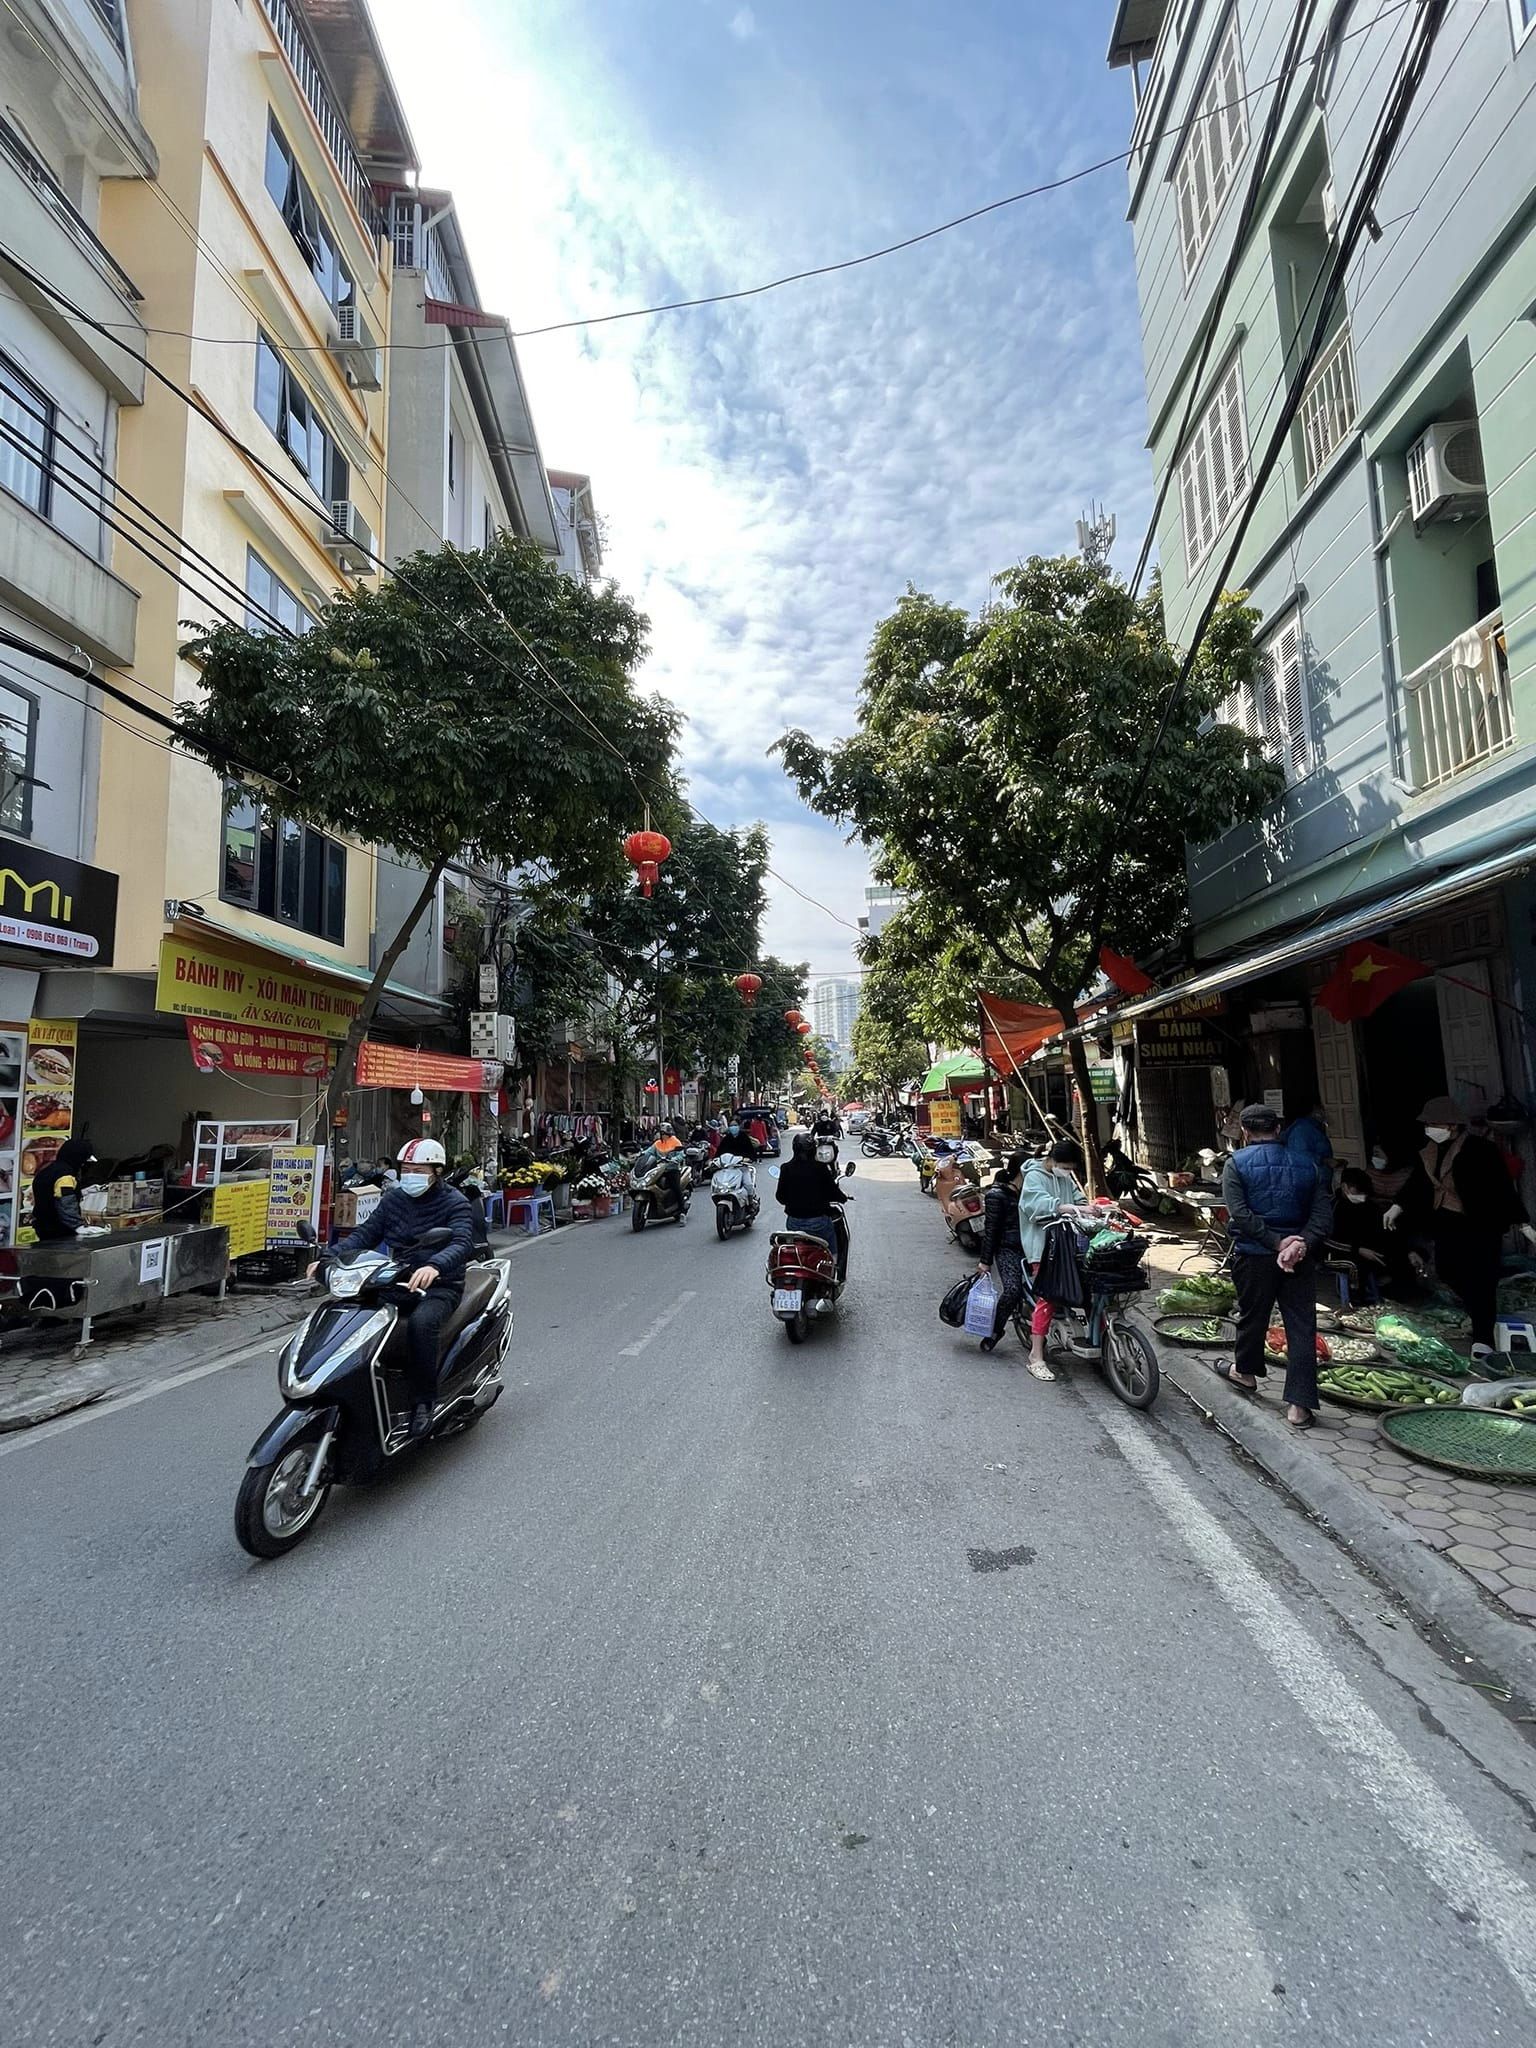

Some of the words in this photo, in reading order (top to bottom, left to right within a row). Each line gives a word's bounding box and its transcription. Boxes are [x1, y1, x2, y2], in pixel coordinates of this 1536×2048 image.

[175, 955, 220, 989] BÁNH
[222, 967, 245, 995] MỲ
[256, 975, 278, 1002] XÔI
[280, 983, 308, 1011] MẶN
[240, 1002, 261, 1020] ĂN
[261, 1007, 294, 1027] SÁNG
[293, 1014, 323, 1031] NGON
[192, 1023, 214, 1041] BÁNH
[226, 1028, 239, 1045] SÀI
[1159, 1020, 1203, 1037] BÁNH
[1140, 1042, 1178, 1058] SINH
[1182, 1040, 1224, 1058] NHẬT
